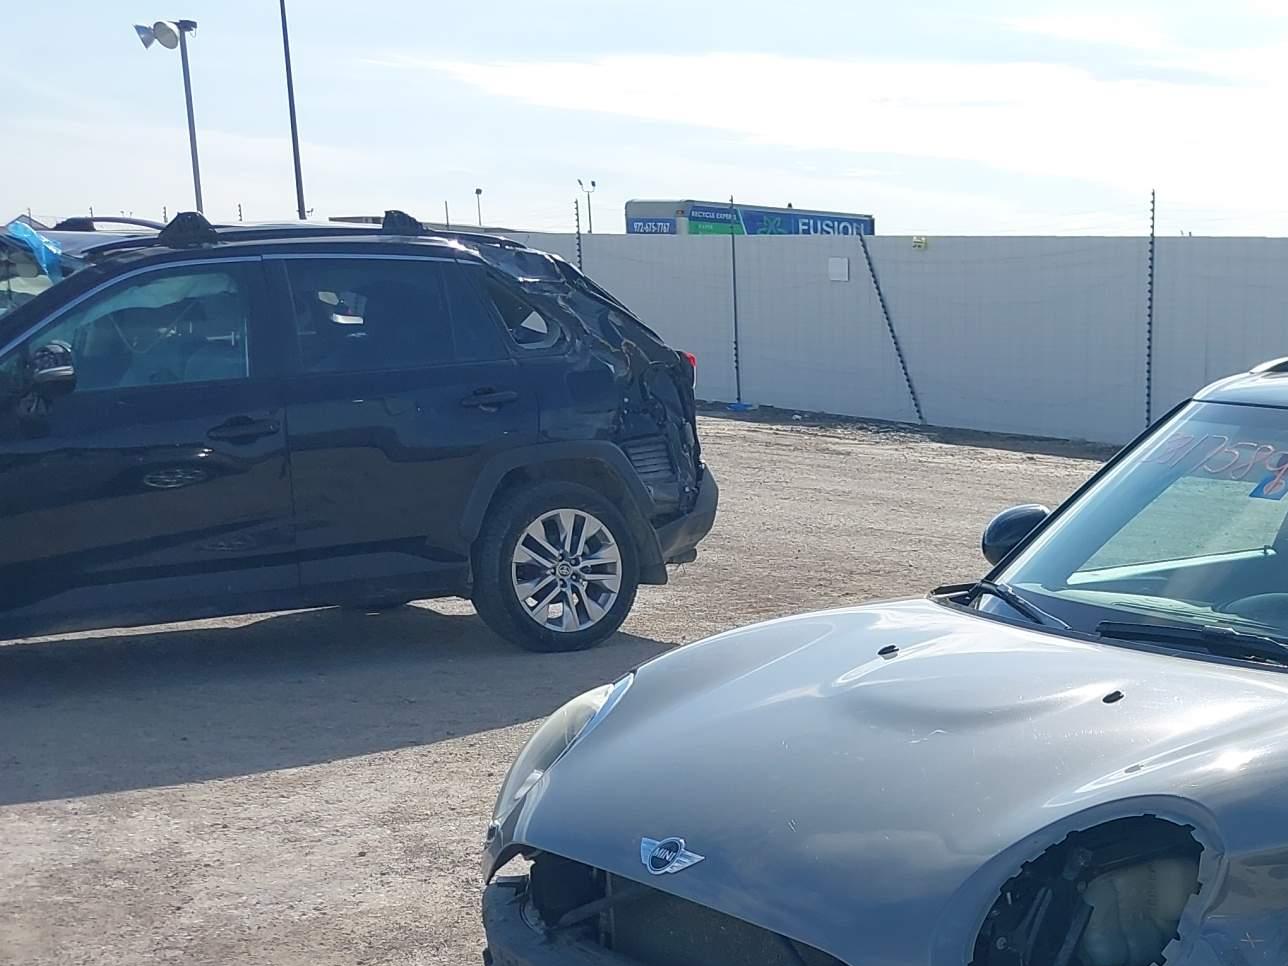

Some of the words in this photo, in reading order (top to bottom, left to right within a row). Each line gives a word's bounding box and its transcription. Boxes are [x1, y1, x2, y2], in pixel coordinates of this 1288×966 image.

[691, 210, 715, 219] RECYCLE
[716, 212, 737, 220] EXPERS
[798, 218, 865, 236] FUSION
[651, 846, 677, 862] MINI
